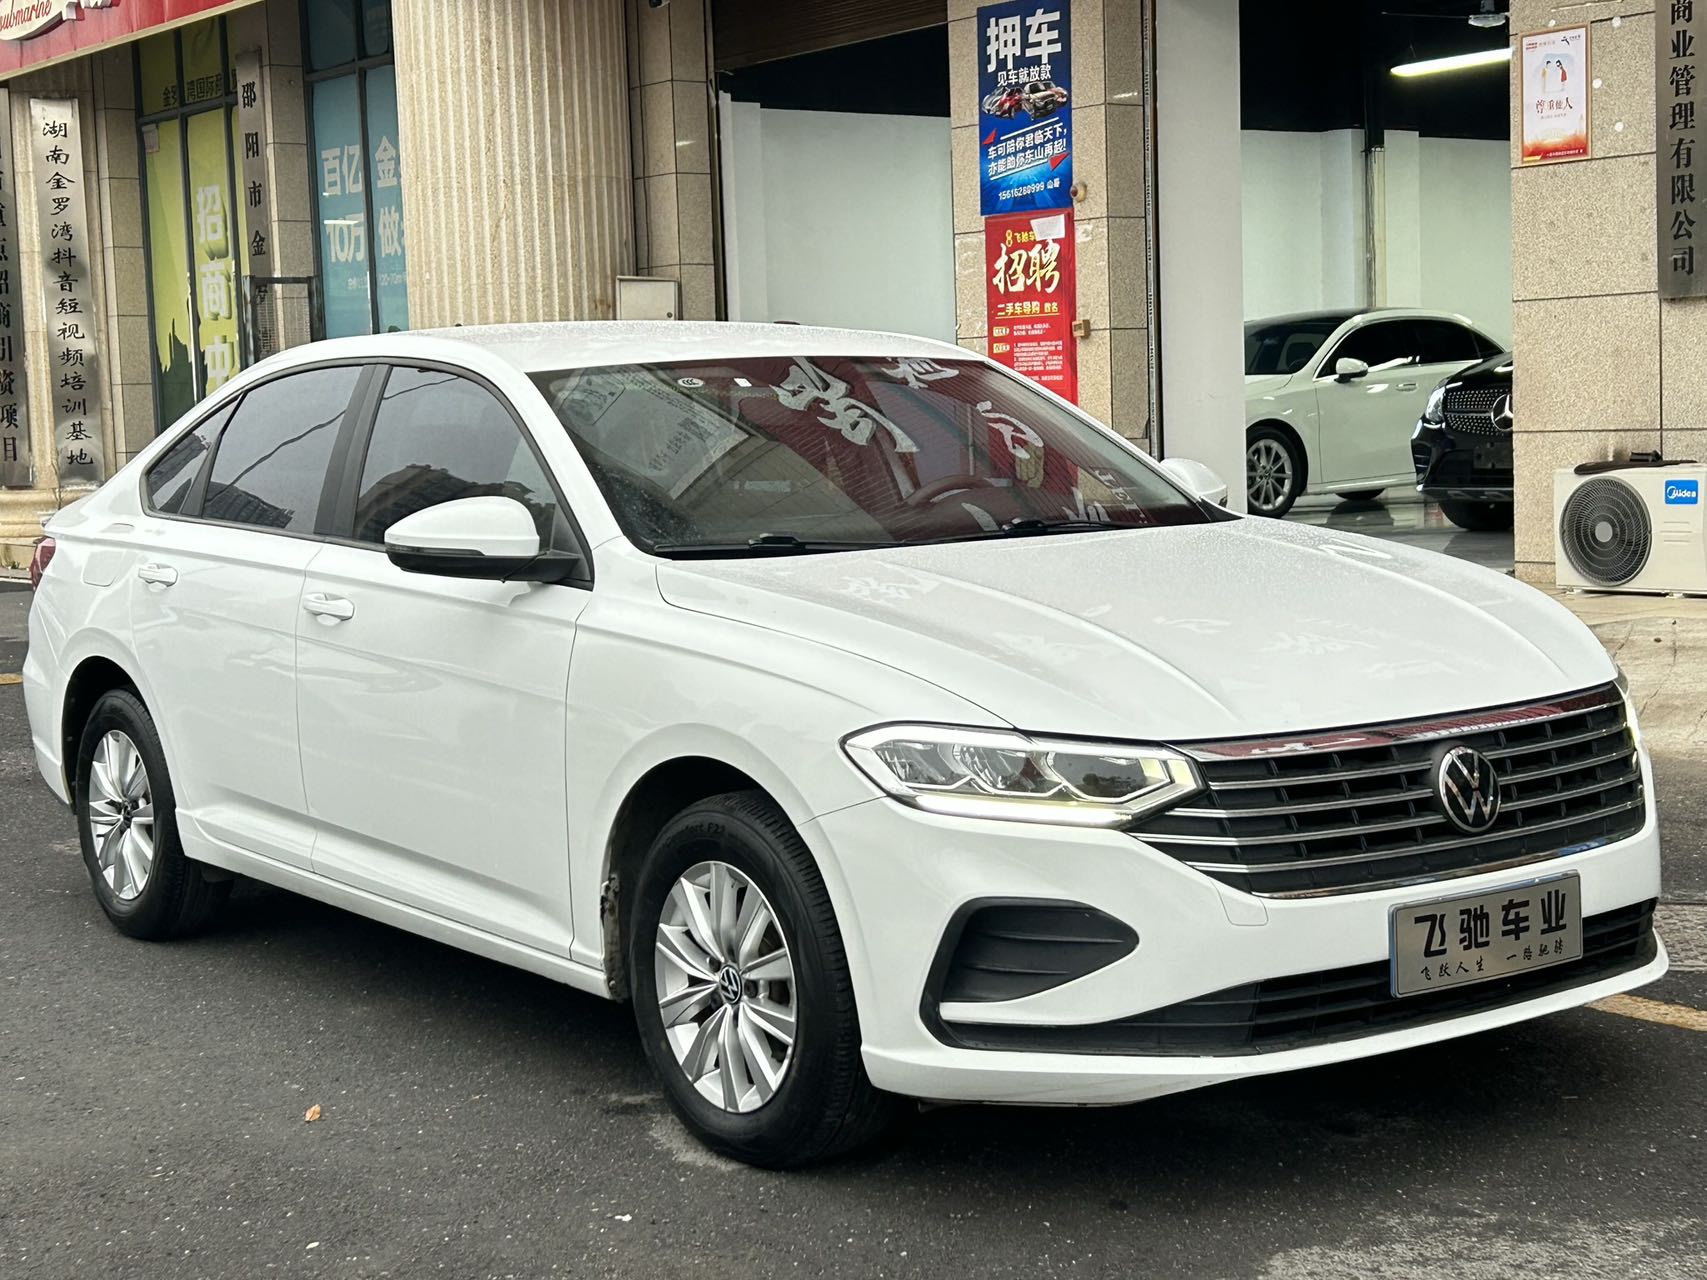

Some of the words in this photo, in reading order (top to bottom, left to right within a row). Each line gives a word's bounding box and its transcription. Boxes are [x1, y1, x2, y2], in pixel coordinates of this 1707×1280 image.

[0, 0, 52, 31] ubmarine
[987, 8, 1062, 73] 押车
[997, 64, 1051, 87] 见车就放款
[1669, 0, 1696, 276] 商业管理有限公司
[43, 121, 94, 465] 湖南金罗湾抖音短视频培训基地
[992, 238, 1060, 294] 招聘
[1666, 485, 1697, 499] Midea
[1414, 889, 1567, 958] 飞驰车业
